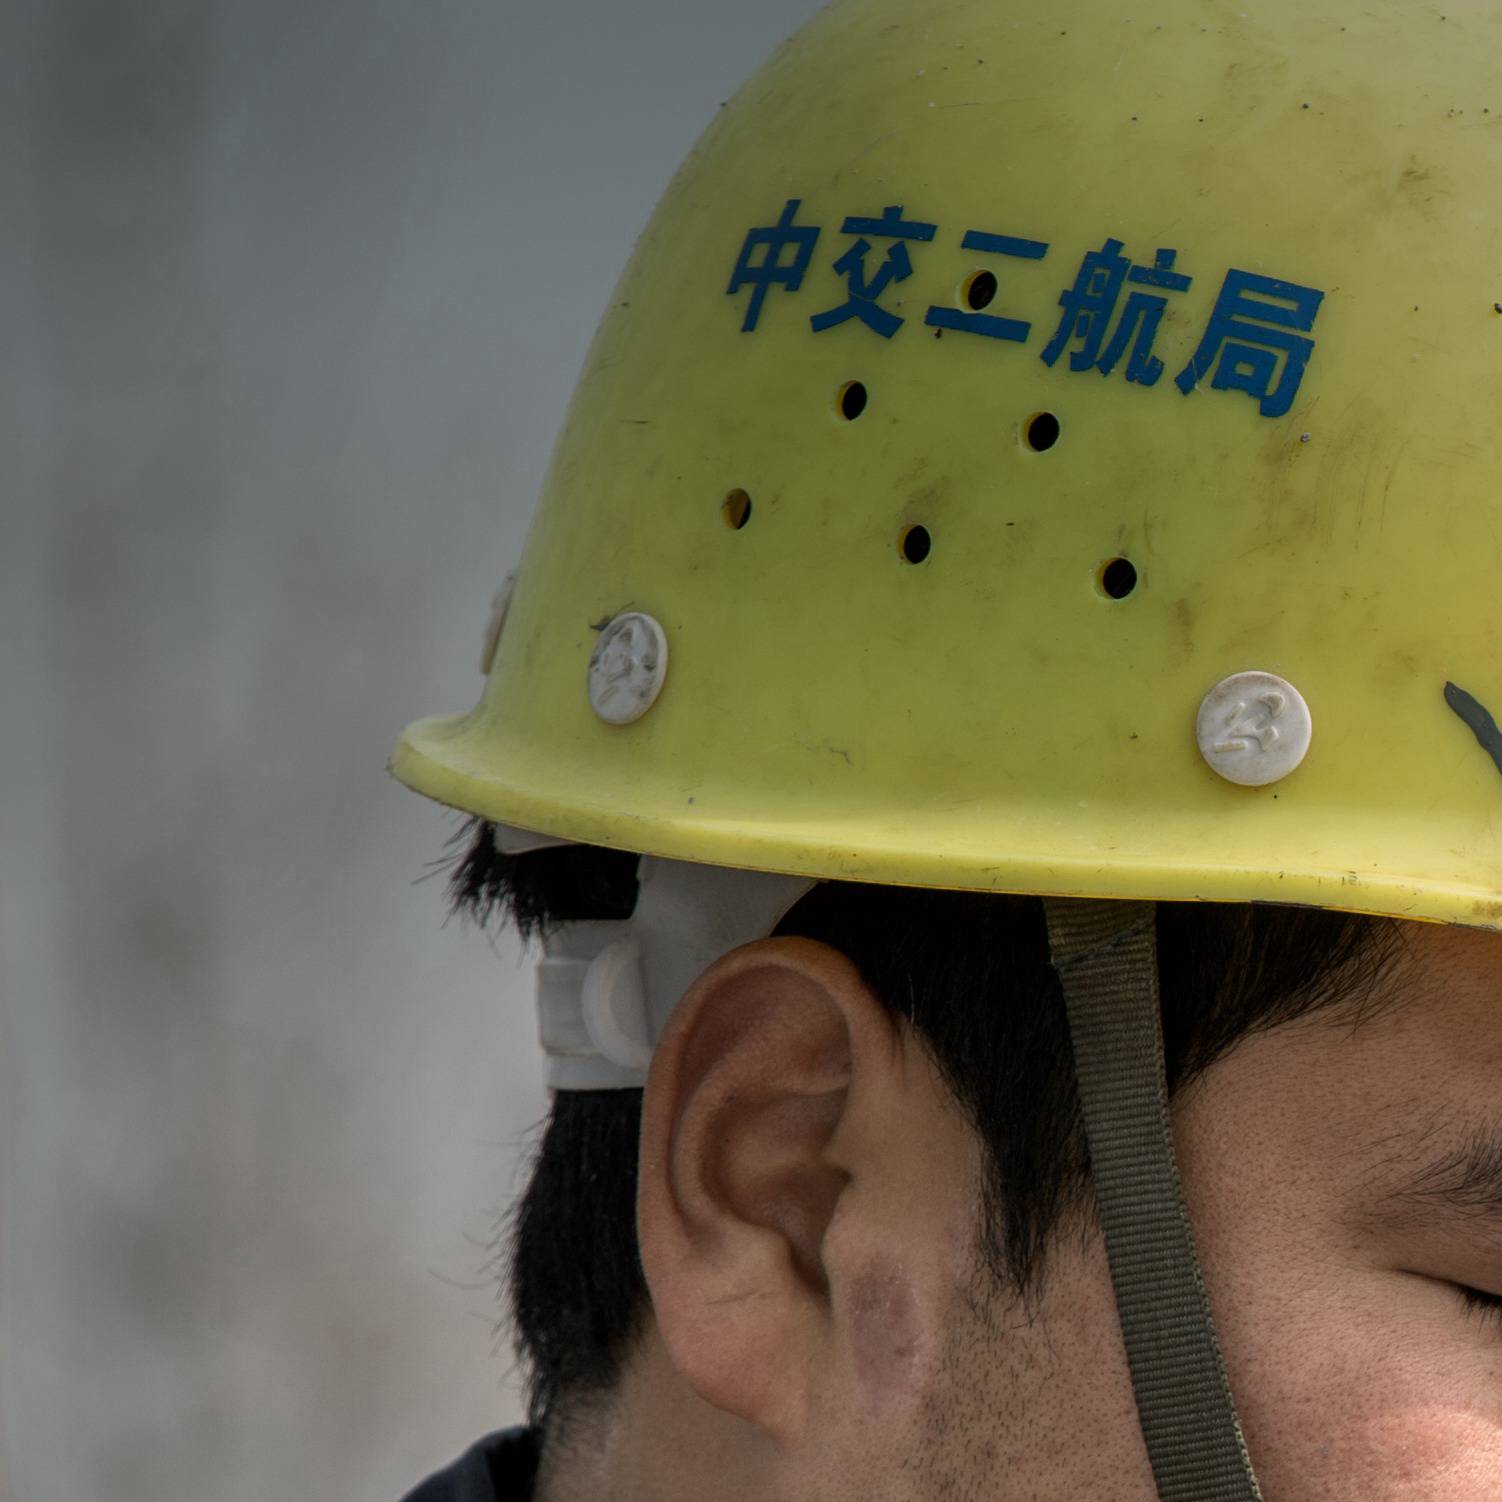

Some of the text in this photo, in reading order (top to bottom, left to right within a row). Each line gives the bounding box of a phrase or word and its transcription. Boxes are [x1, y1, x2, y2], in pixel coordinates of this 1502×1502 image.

[726, 199, 1325, 418] 中交二航局
